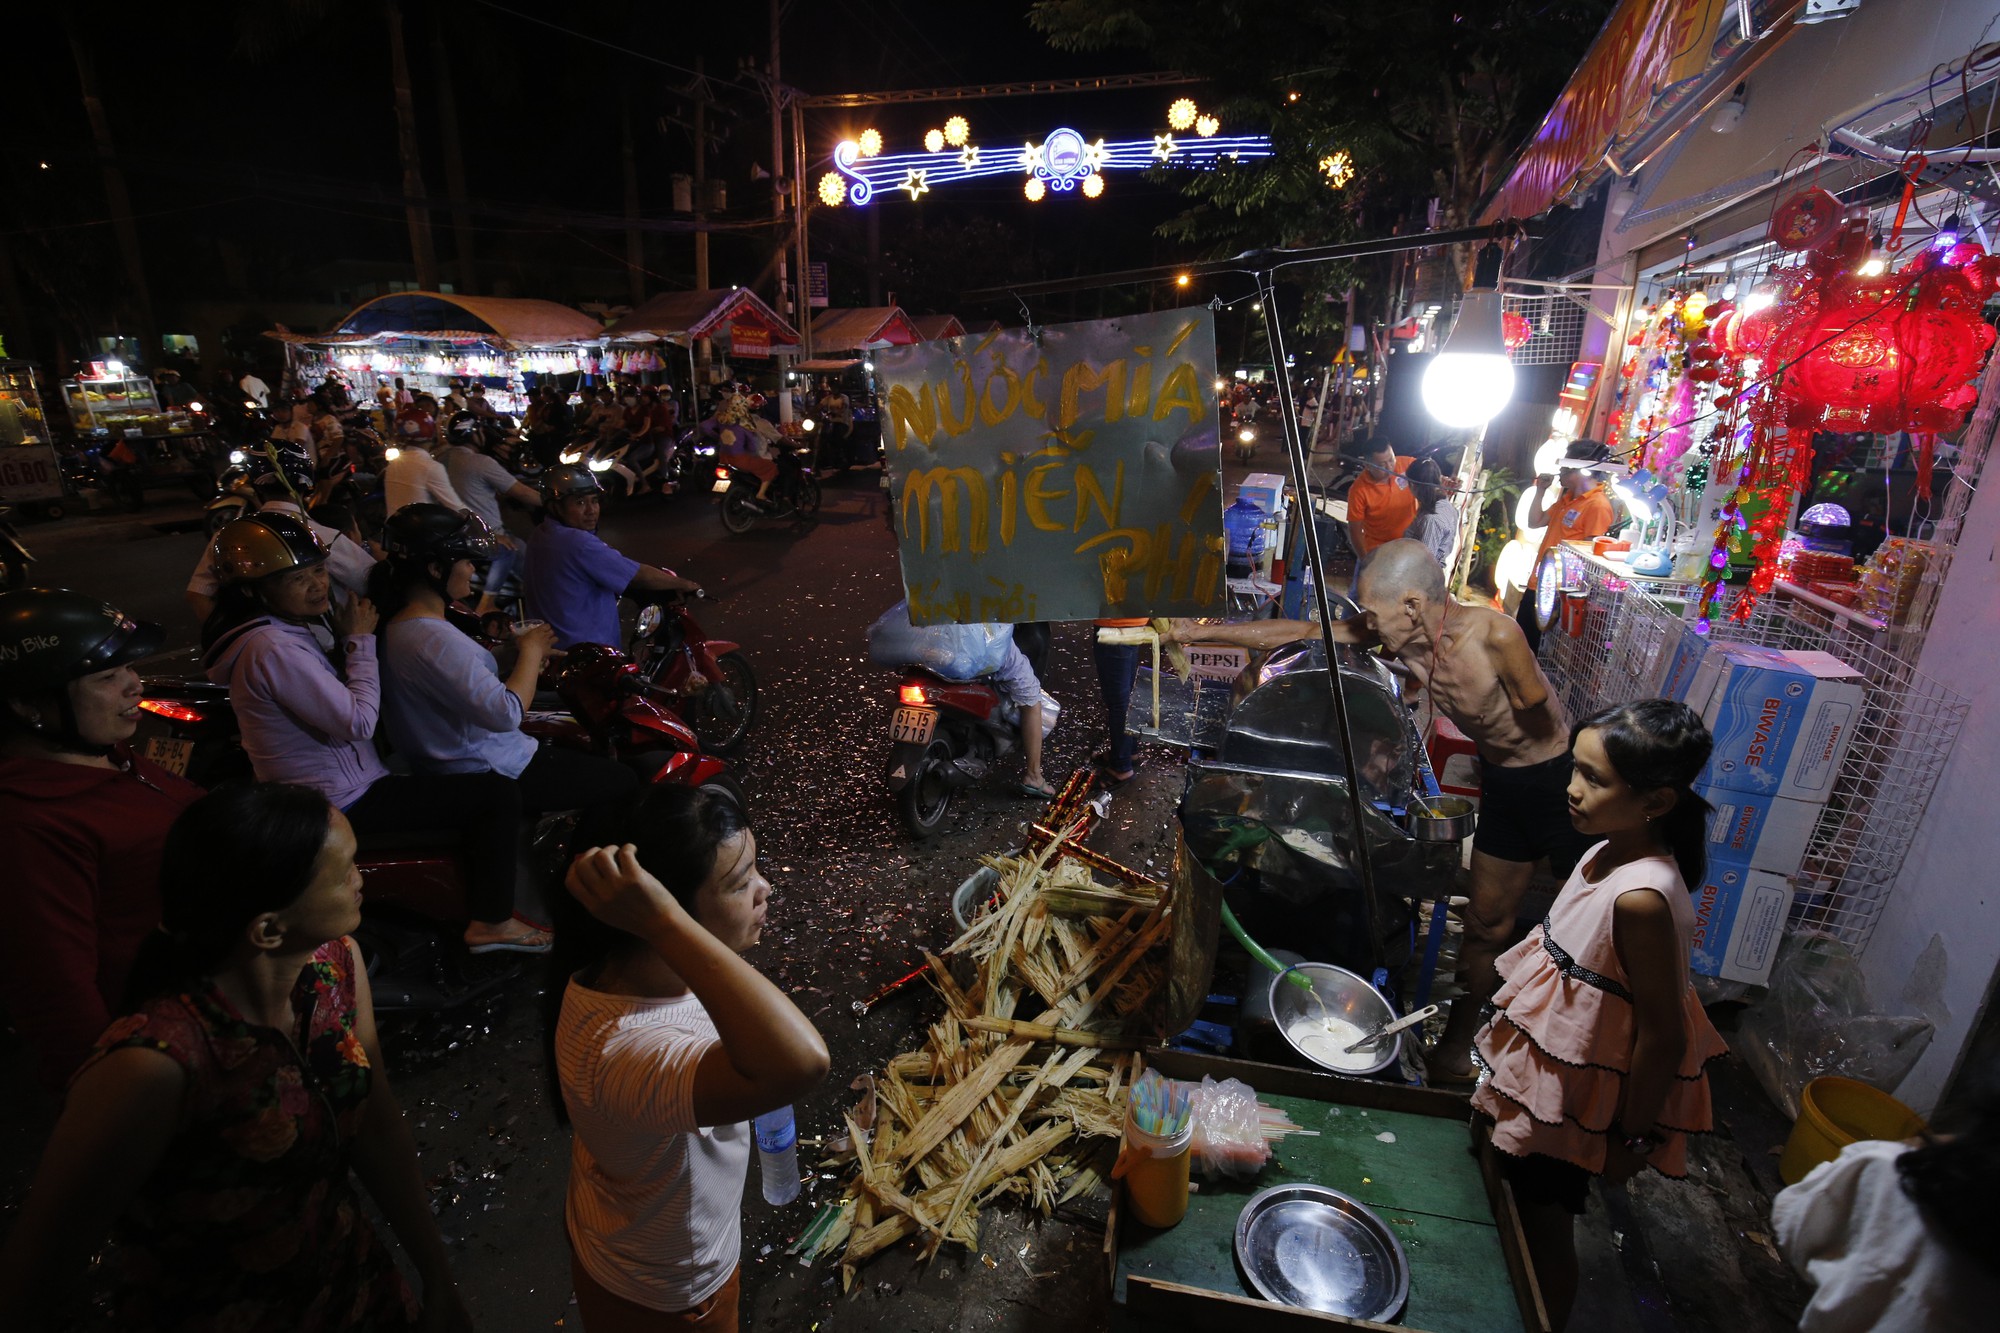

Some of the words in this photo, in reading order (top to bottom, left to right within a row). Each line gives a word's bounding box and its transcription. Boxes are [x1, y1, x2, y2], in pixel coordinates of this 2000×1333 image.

[21, 634, 60, 654] Bike
[1191, 653, 1240, 668] PEPSI
[897, 709, 930, 727] 61-T5
[893, 725, 926, 742] 6718
[1744, 698, 1781, 767] BIWASE
[1823, 725, 1841, 762] BIWASE
[1730, 805, 1755, 850] BIWASE
